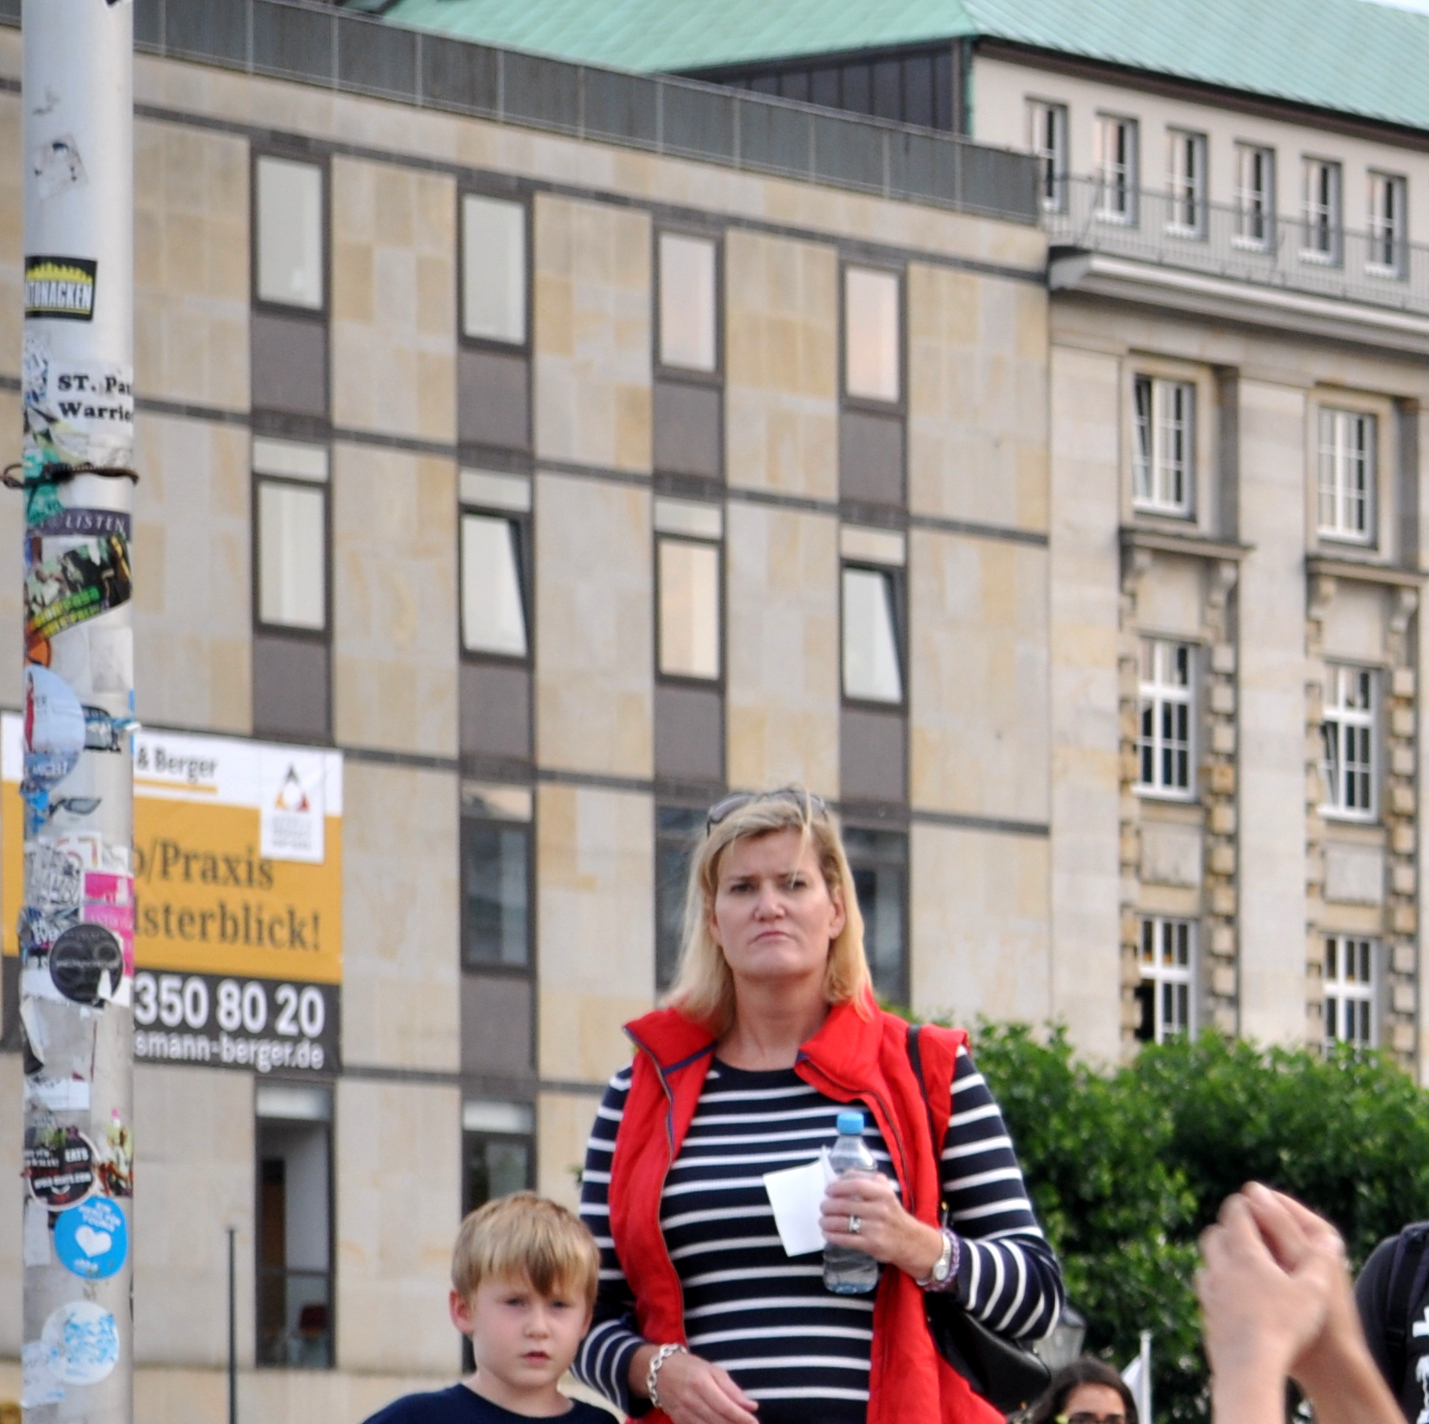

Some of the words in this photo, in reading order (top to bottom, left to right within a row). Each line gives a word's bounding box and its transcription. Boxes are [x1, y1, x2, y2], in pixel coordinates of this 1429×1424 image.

[137, 751, 149, 771] &
[155, 751, 217, 784] Berger
[134, 971, 208, 1029] 350
[216, 979, 267, 1034] 80
[275, 983, 325, 1038] 20
